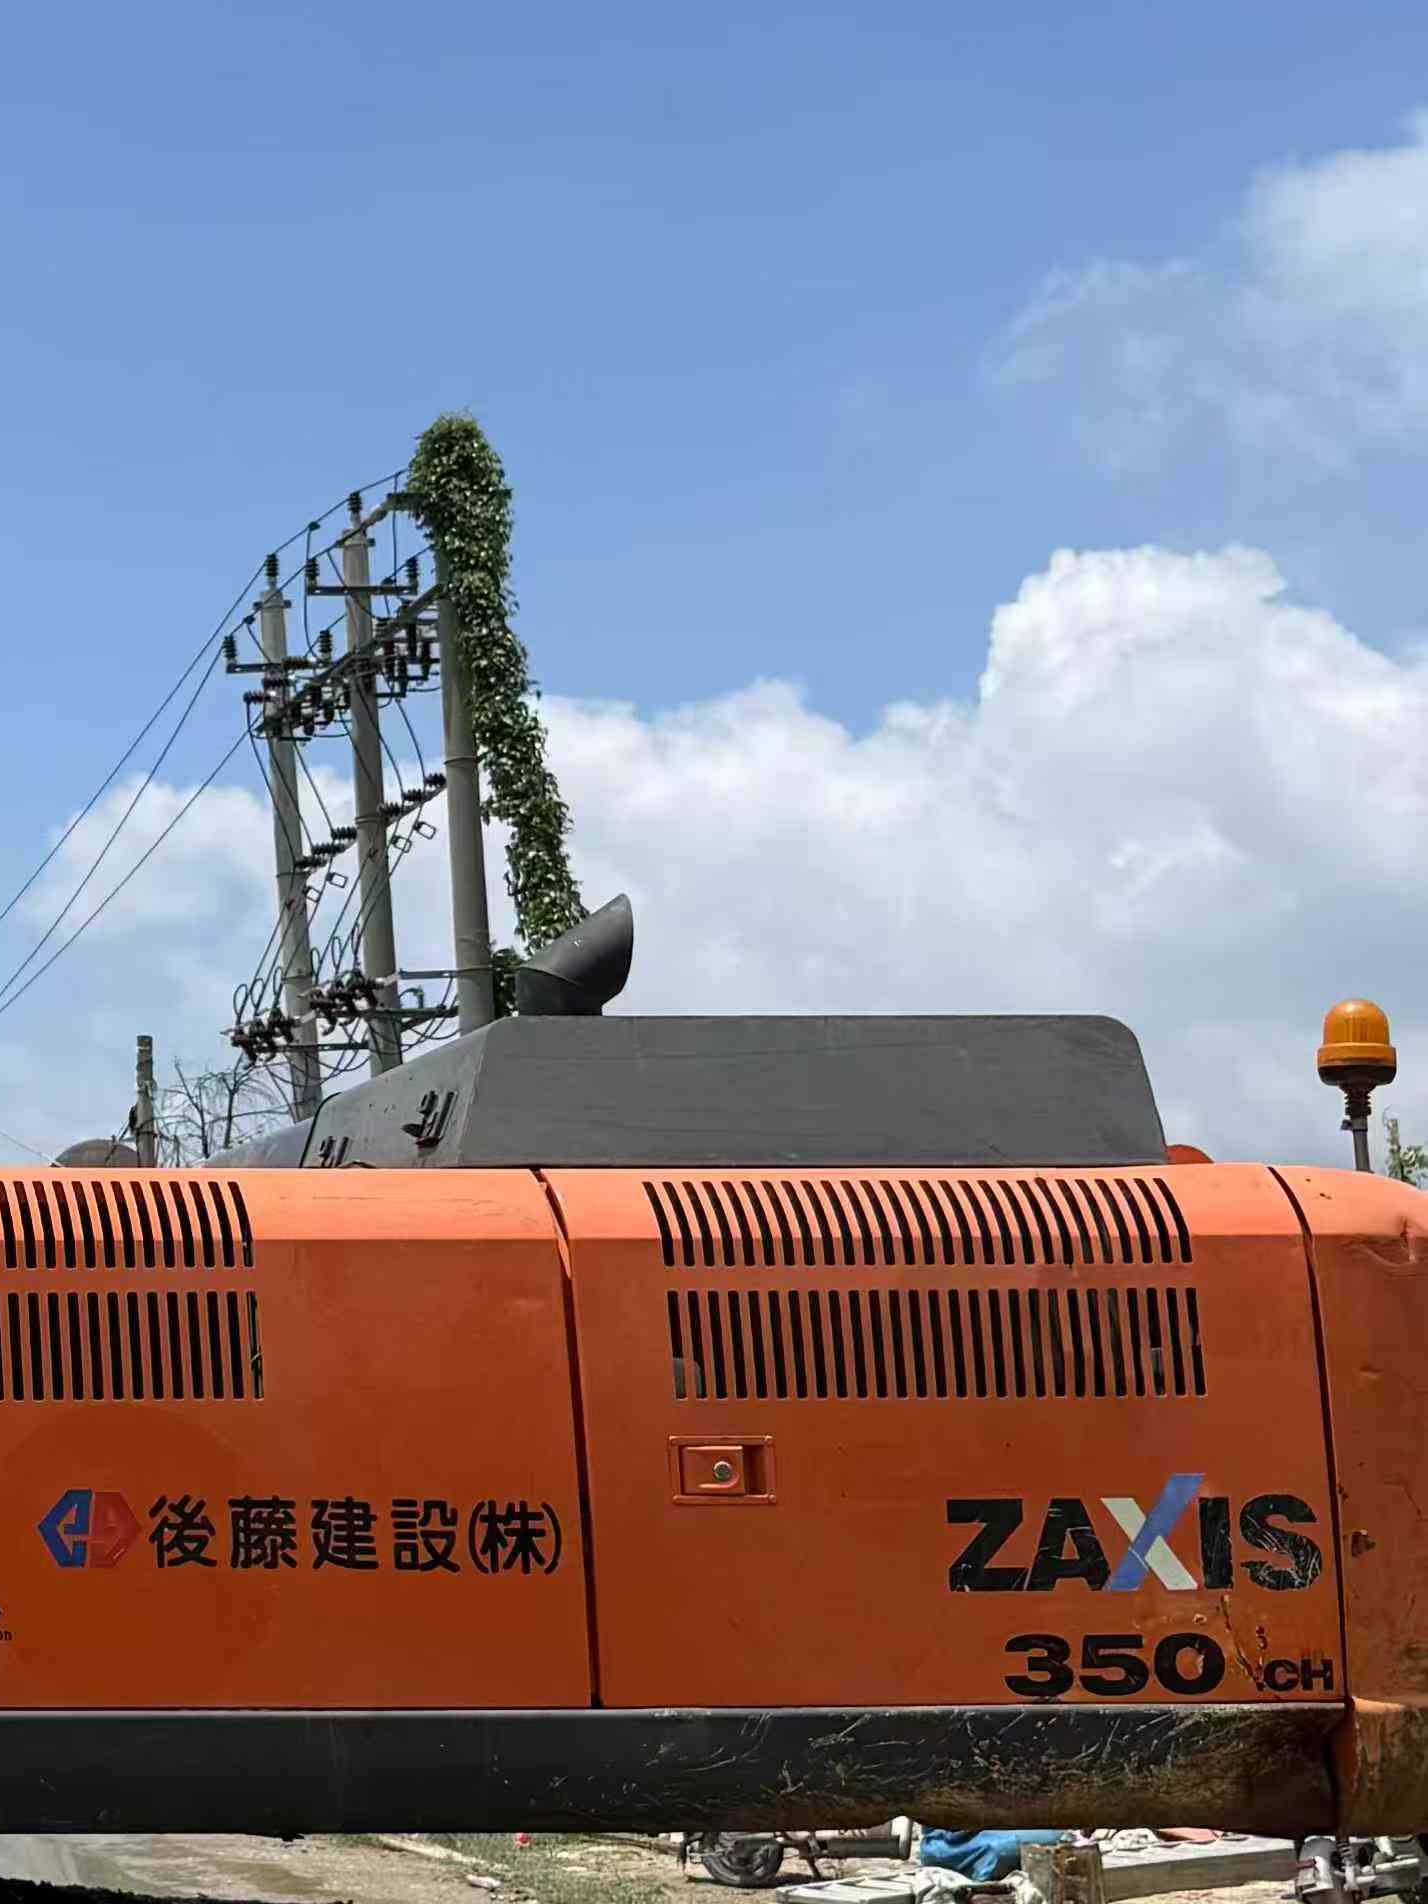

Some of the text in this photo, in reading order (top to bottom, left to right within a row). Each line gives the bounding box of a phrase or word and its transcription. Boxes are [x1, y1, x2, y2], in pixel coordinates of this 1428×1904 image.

[148, 1495, 562, 1575] 後藤建設(株)
[945, 1473, 1321, 1593] ZAXIS
[1004, 1633, 1226, 1696] 350
